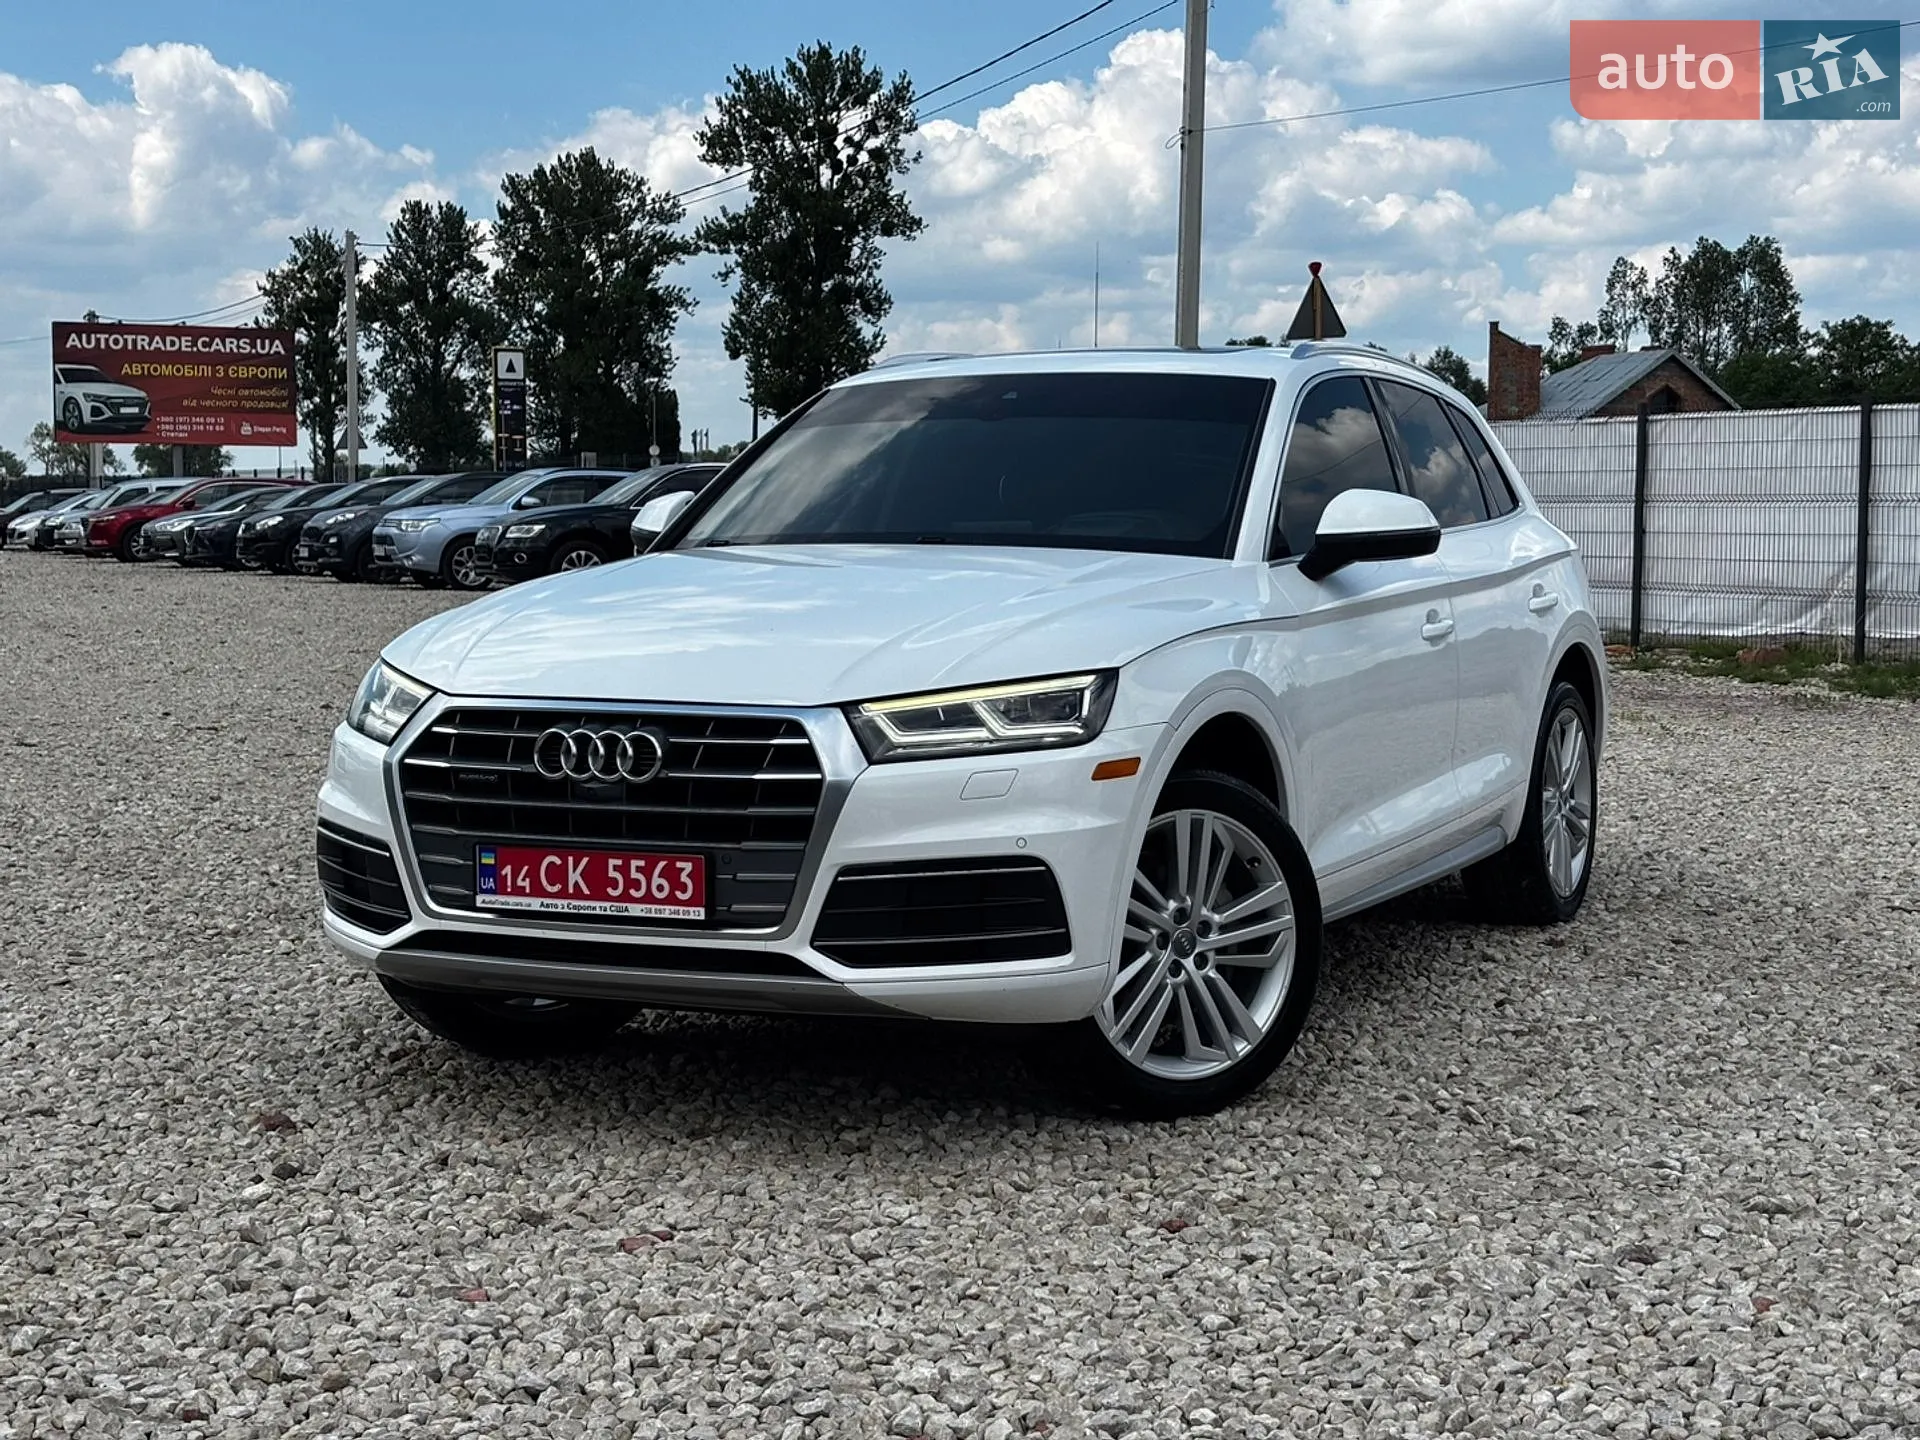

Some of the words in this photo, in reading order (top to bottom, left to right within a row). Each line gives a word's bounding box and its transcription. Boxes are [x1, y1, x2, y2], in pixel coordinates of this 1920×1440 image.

[65, 332, 286, 355] AUTOTRADE.CARS.UA
[121, 362, 212, 378] АВТОМОБІЛІ
[228, 365, 288, 380] ЄВРОПИ
[480, 877, 496, 890] UA
[500, 865, 531, 894] 14
[539, 855, 591, 895] CK
[606, 858, 695, 901] 5563
[539, 901, 559, 911] Авто
[609, 905, 631, 914] США
